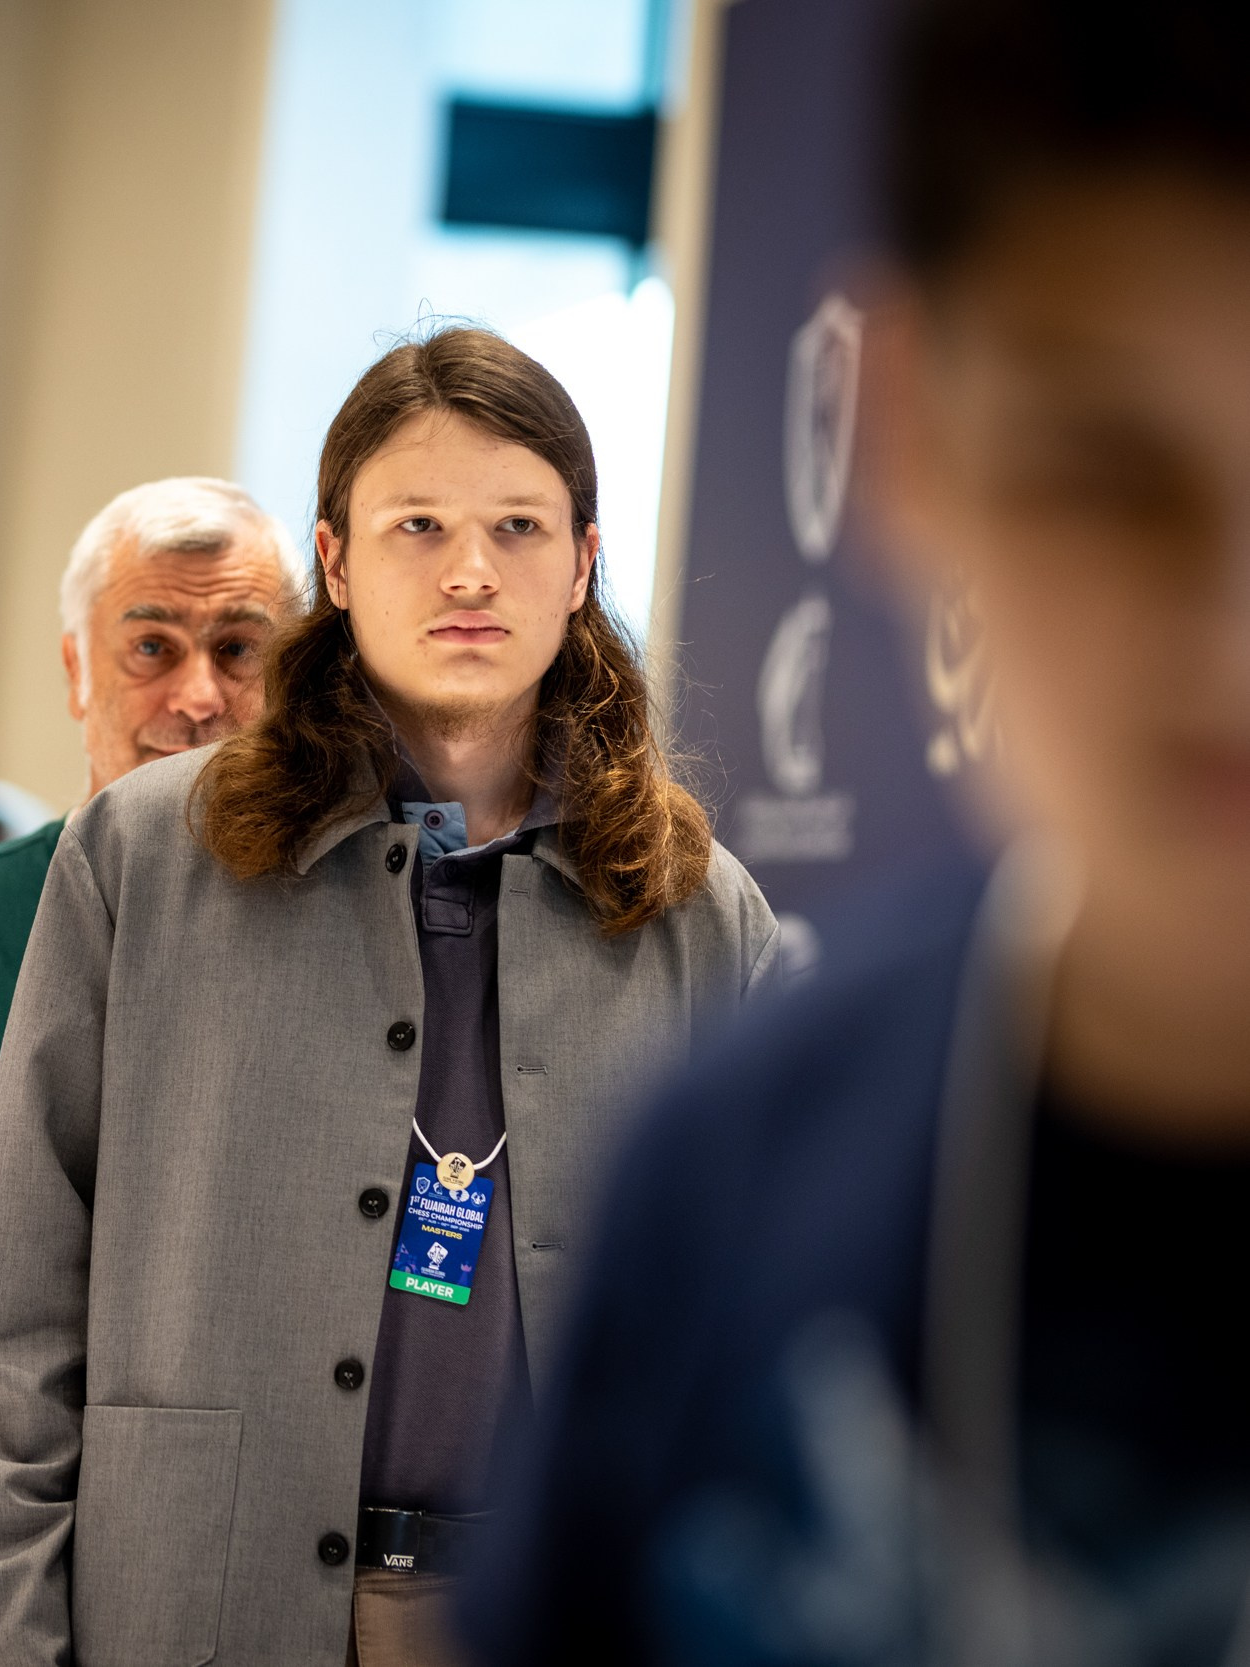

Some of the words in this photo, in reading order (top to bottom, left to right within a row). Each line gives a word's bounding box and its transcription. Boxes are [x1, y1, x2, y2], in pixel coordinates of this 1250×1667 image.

[408, 1206, 430, 1218] CHESS
[430, 1212, 483, 1231] CHAMPIONSHIP
[420, 1197, 456, 1217] FUJAIRAH
[456, 1206, 485, 1224] GLOBAL
[421, 1224, 463, 1240] MASTERS
[405, 1276, 454, 1299] PLAYER
